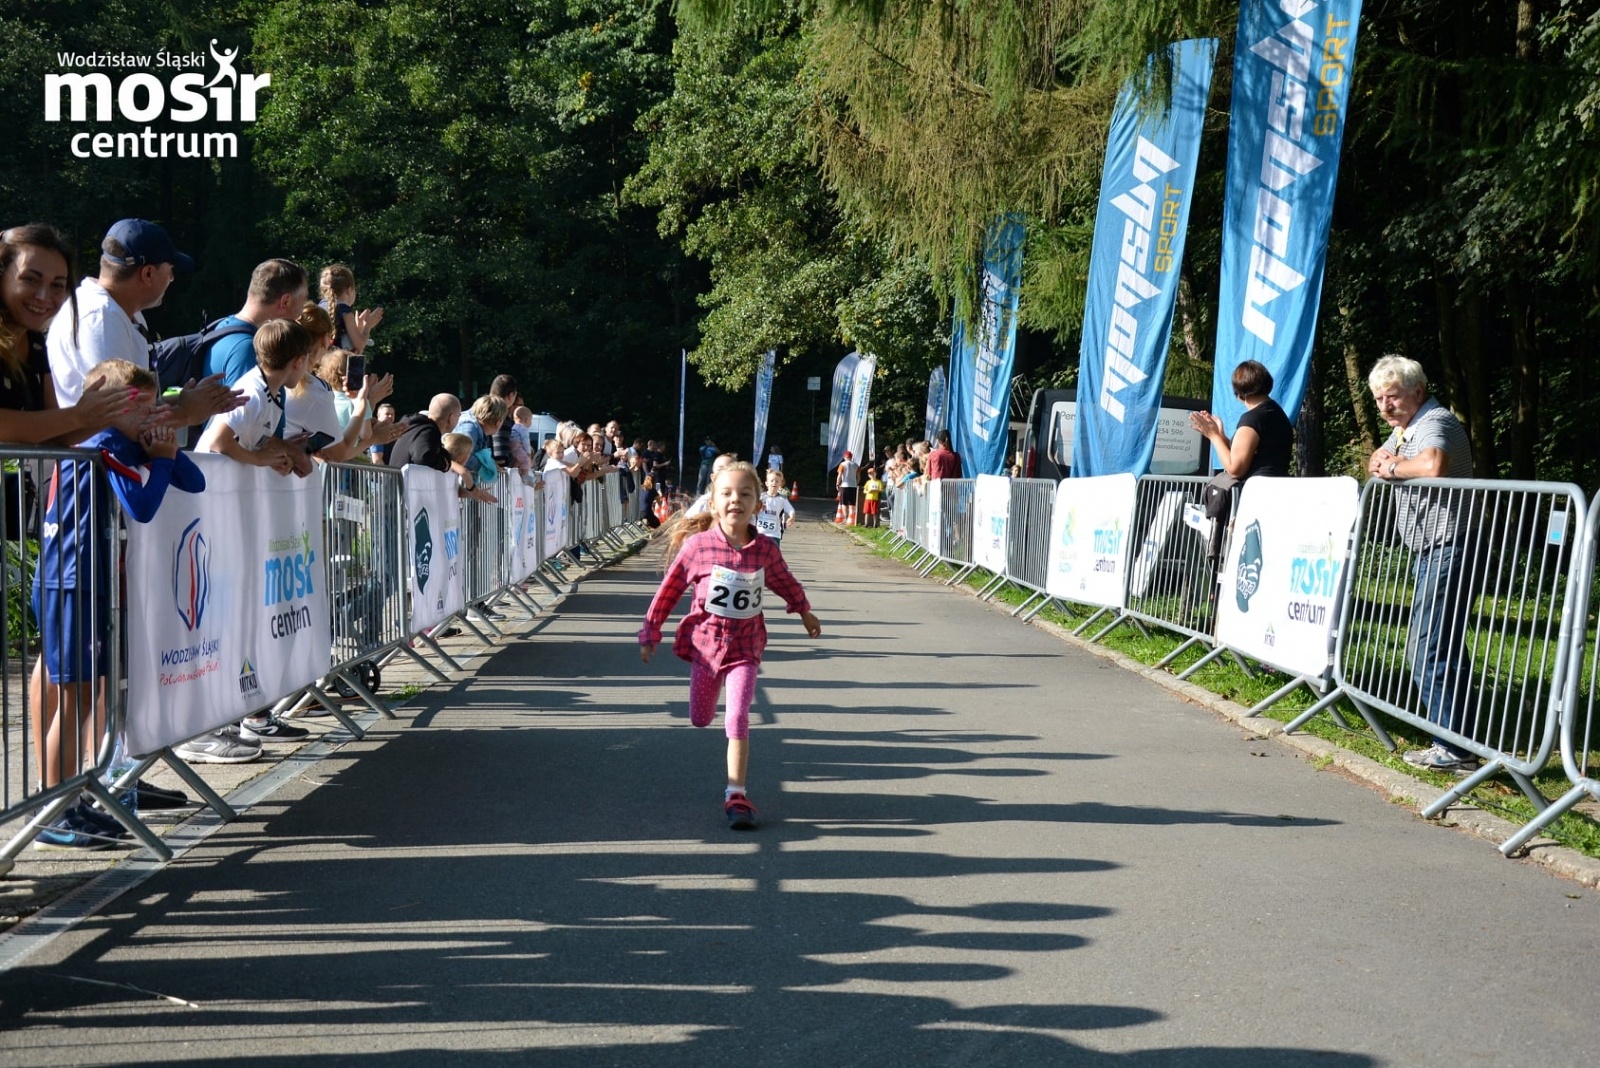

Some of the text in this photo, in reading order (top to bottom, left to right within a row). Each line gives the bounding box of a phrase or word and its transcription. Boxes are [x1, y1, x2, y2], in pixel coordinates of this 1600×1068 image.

[1313, 13, 1350, 137] SPORT
[1154, 183, 1183, 273] SPORT
[265, 550, 315, 606] mosr
[710, 585, 762, 610] 263
